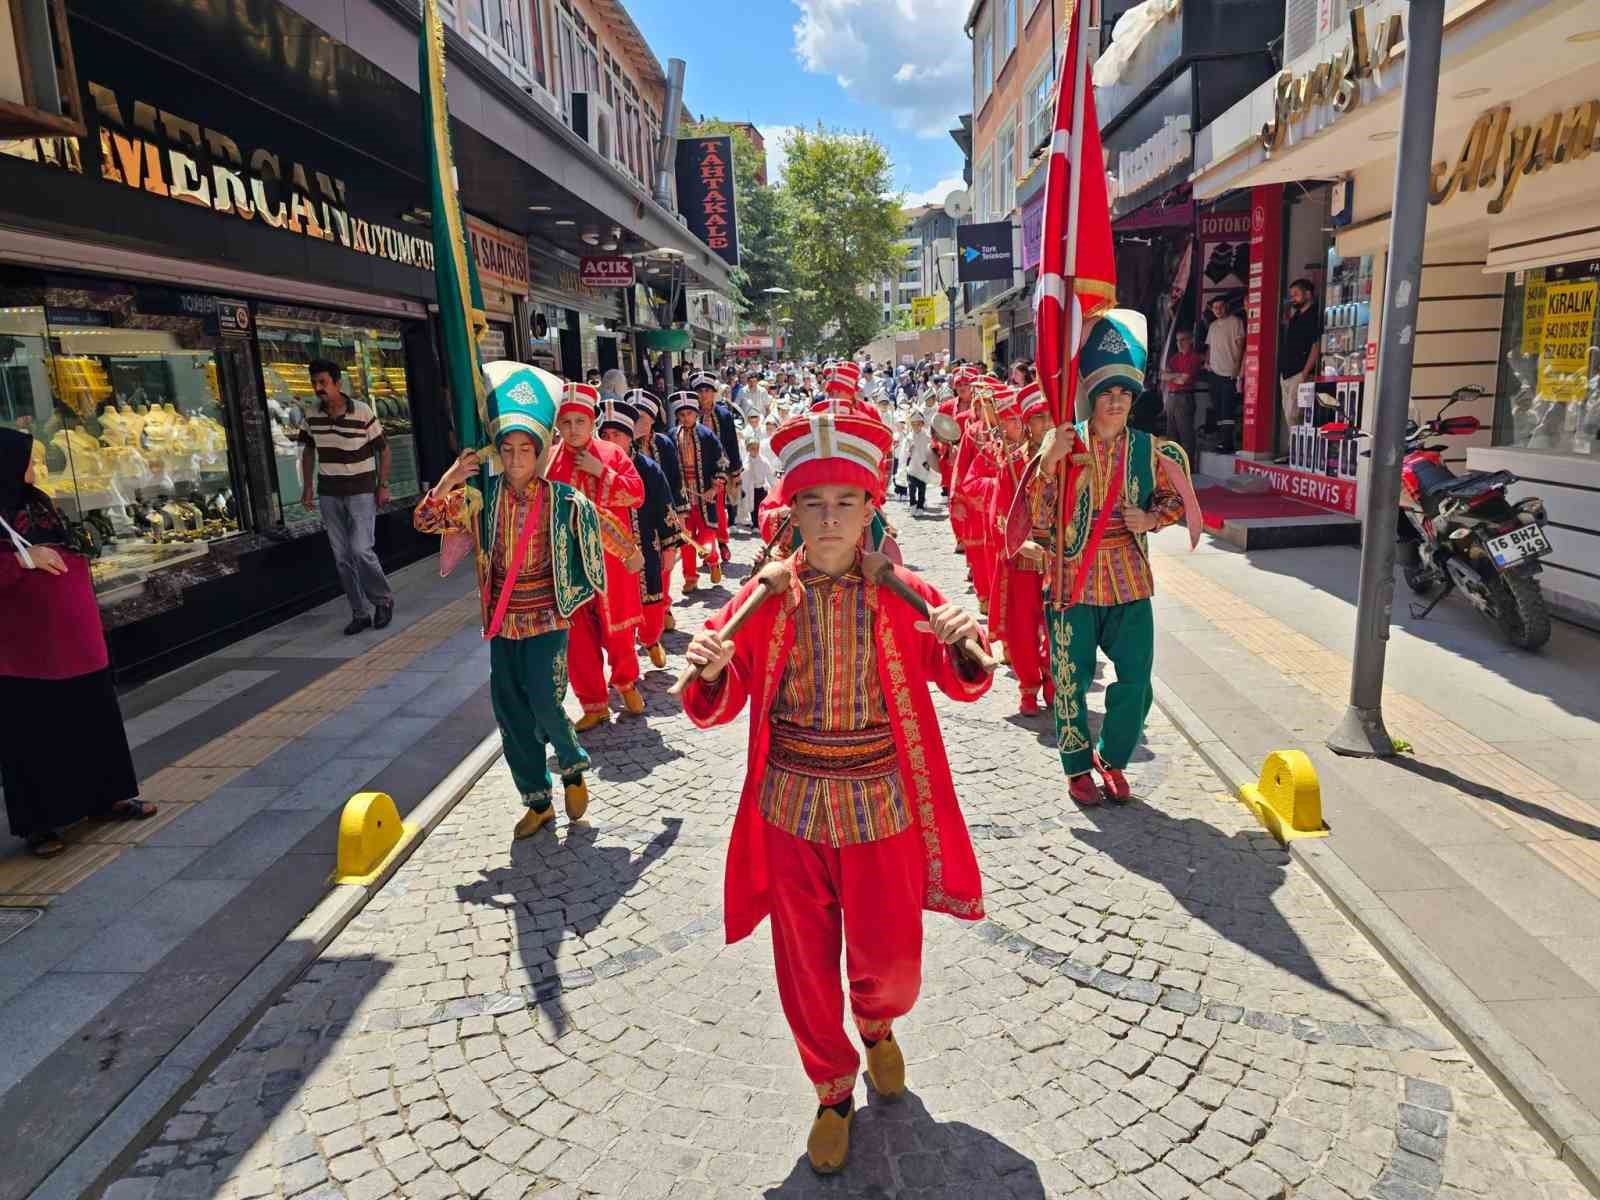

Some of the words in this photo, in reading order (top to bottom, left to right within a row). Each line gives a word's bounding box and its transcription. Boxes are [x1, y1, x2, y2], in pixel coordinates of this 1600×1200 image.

[88, 80, 351, 247] MERCAN
[700, 141, 728, 249] TAHTAKALE
[584, 261, 629, 277] AÇIK
[1491, 538, 1508, 552] 16
[1510, 526, 1539, 545] BHZ
[1516, 538, 1545, 556] 349
